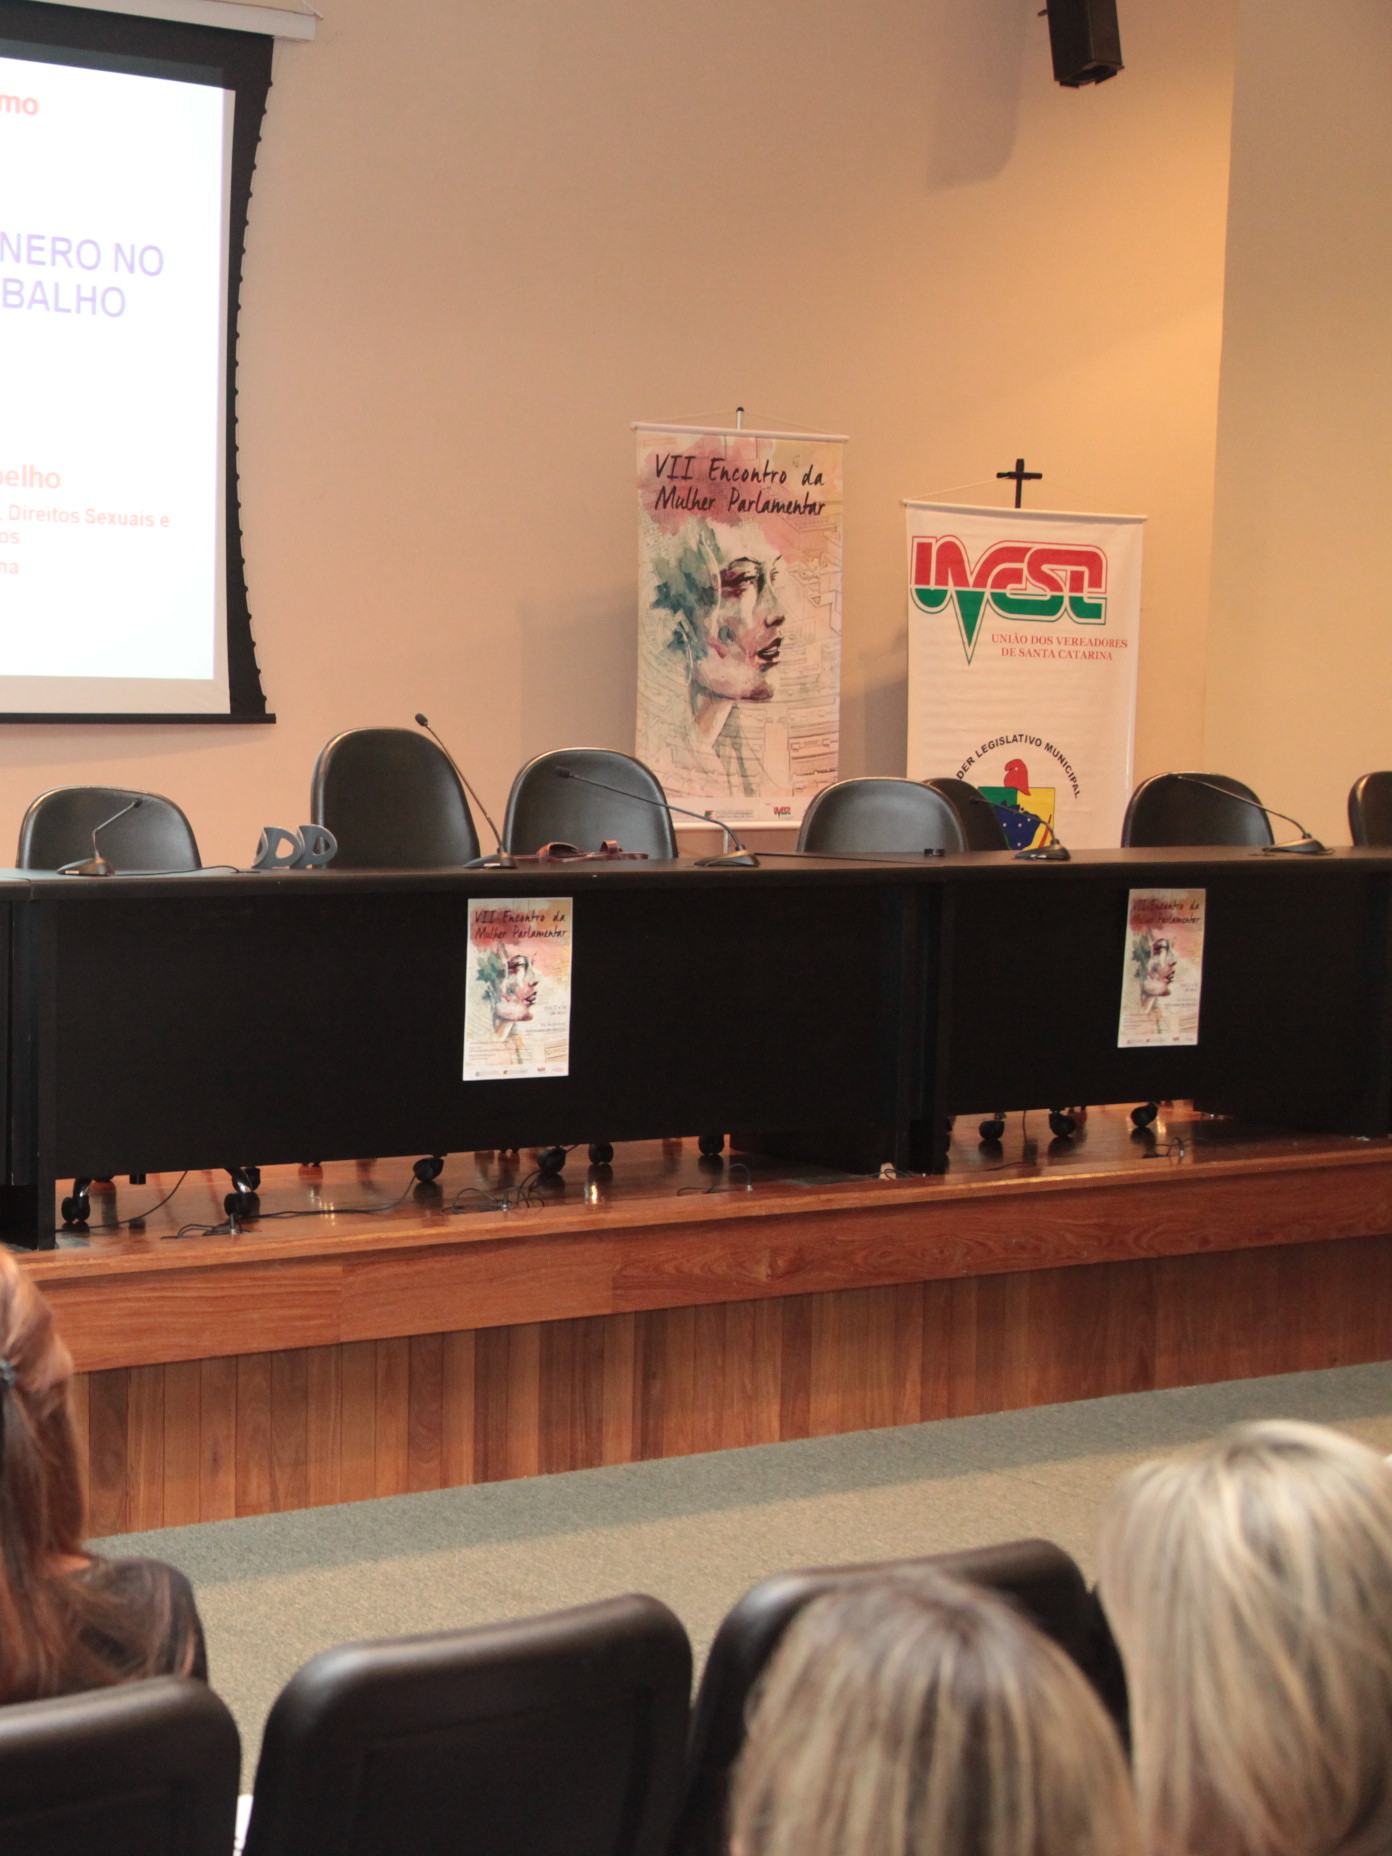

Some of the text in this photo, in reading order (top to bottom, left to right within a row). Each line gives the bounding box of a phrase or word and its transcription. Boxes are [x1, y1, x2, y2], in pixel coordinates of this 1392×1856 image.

[114, 242, 165, 277] NO
[655, 452, 825, 486] VII Encontro da
[654, 486, 826, 516] Mulher Parlamentar
[8, 504, 80, 525] Direitos
[85, 508, 155, 529] Sexuais
[159, 514, 171, 528] e
[991, 632, 1128, 649] UNIÃO DOS VEREADORES
[1001, 648, 1113, 662] DE SANTA CATARINA
[955, 733, 1082, 799] DER LEGISLATIVO MUNICIPAL
[503, 909, 546, 923] Encontro
[553, 910, 565, 922] da
[512, 925, 567, 939] Parlamentar
